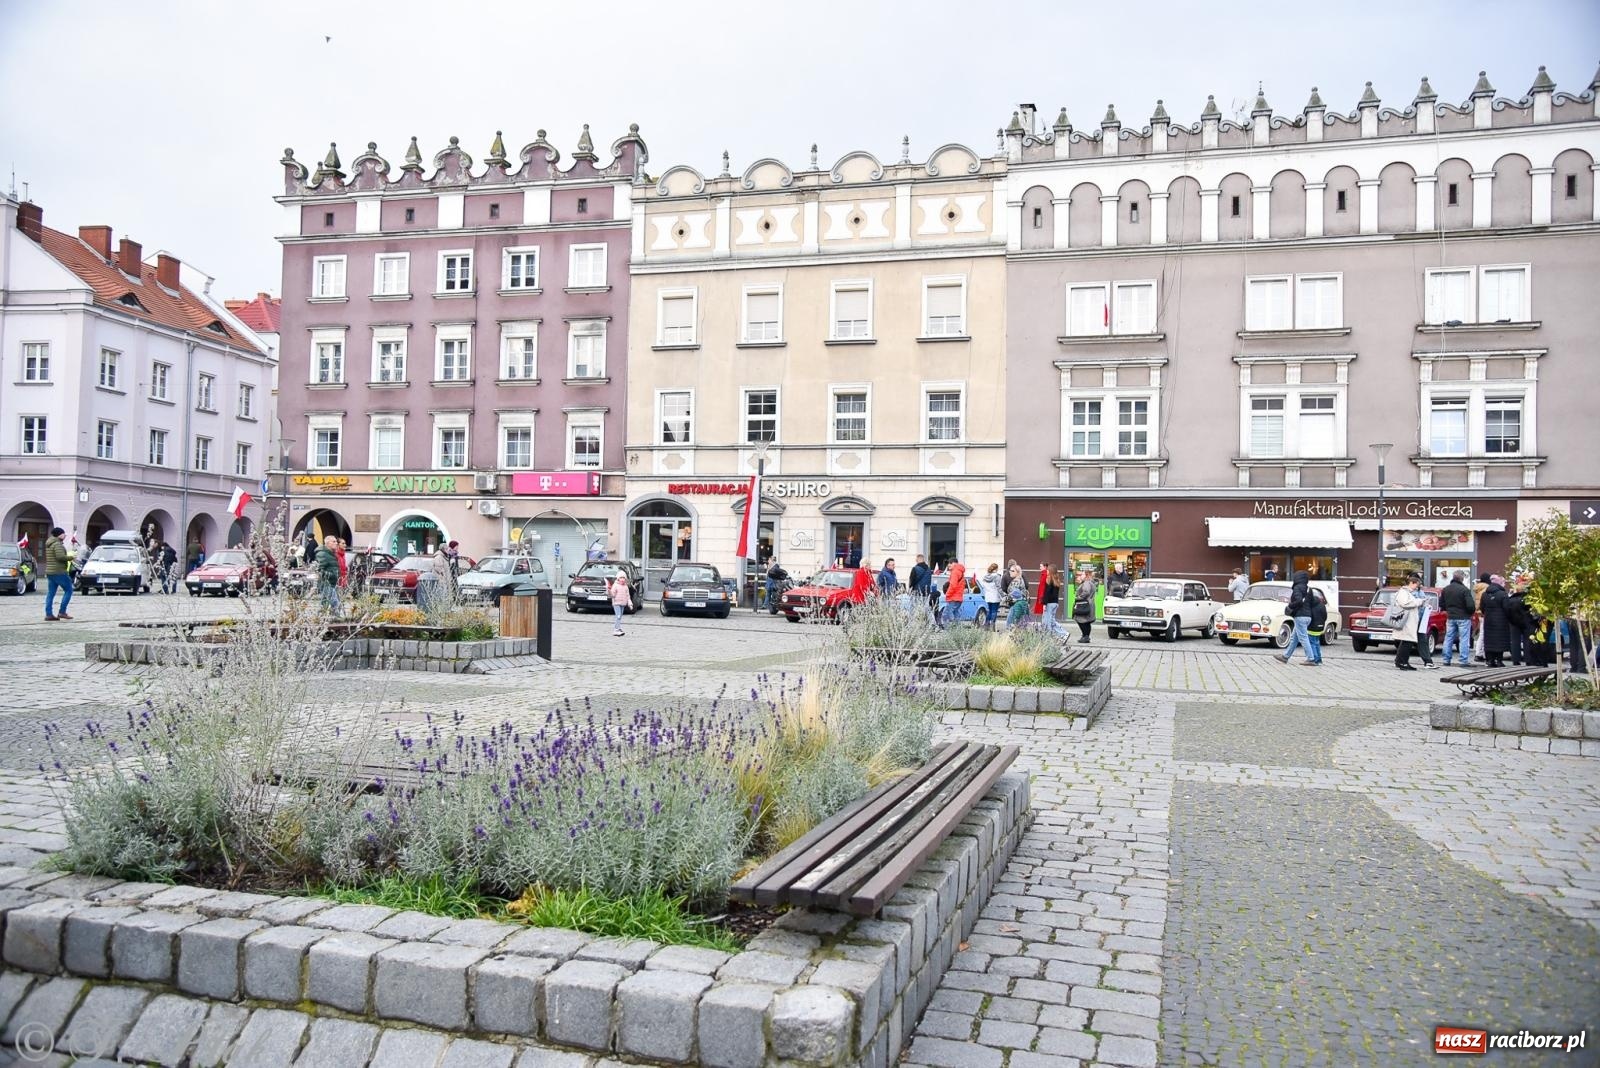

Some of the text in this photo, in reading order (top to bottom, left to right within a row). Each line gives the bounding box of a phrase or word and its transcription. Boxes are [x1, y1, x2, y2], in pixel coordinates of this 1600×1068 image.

[373, 476, 457, 493] KANTOR
[668, 484, 749, 496] RESTAURACJA
[1253, 499, 1473, 519] Manufaktura Lodów Gałeczka
[405, 521, 435, 529] KANTOR
[1076, 524, 1140, 542] żabka
